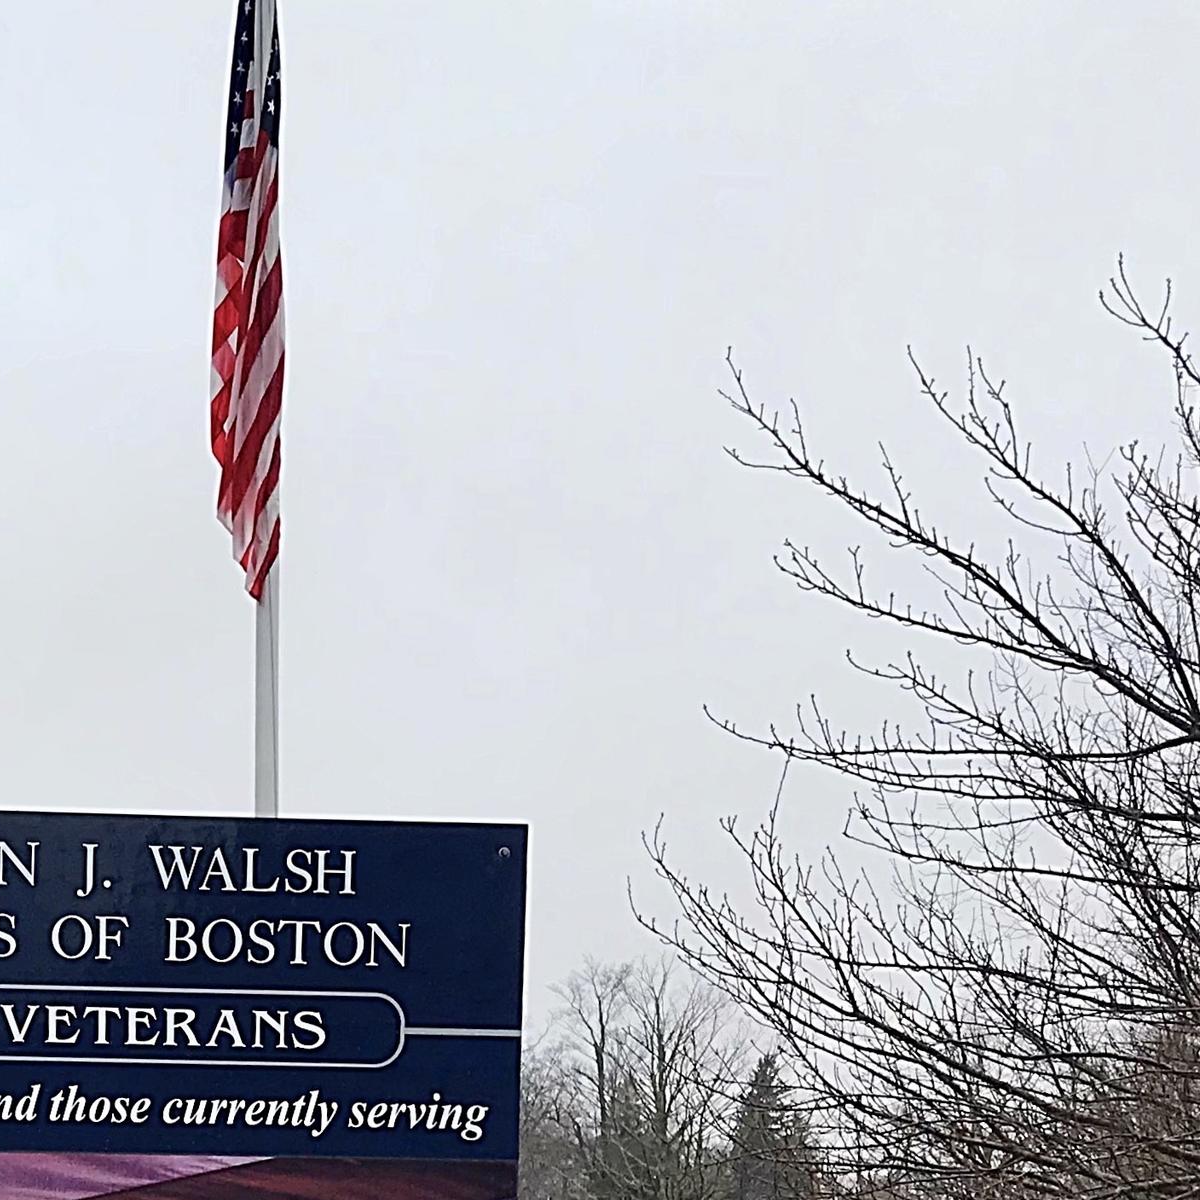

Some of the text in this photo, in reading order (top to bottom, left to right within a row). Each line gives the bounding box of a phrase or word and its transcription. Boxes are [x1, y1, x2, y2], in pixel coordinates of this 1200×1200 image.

[76, 843, 112, 897] J.
[148, 844, 357, 895] WALSH
[51, 914, 130, 960] OF
[164, 917, 411, 968] BOSTON
[0, 1004, 326, 1050] VETERANS
[49, 1084, 152, 1124] those
[162, 1089, 339, 1138] currently
[347, 1092, 489, 1141] serving
